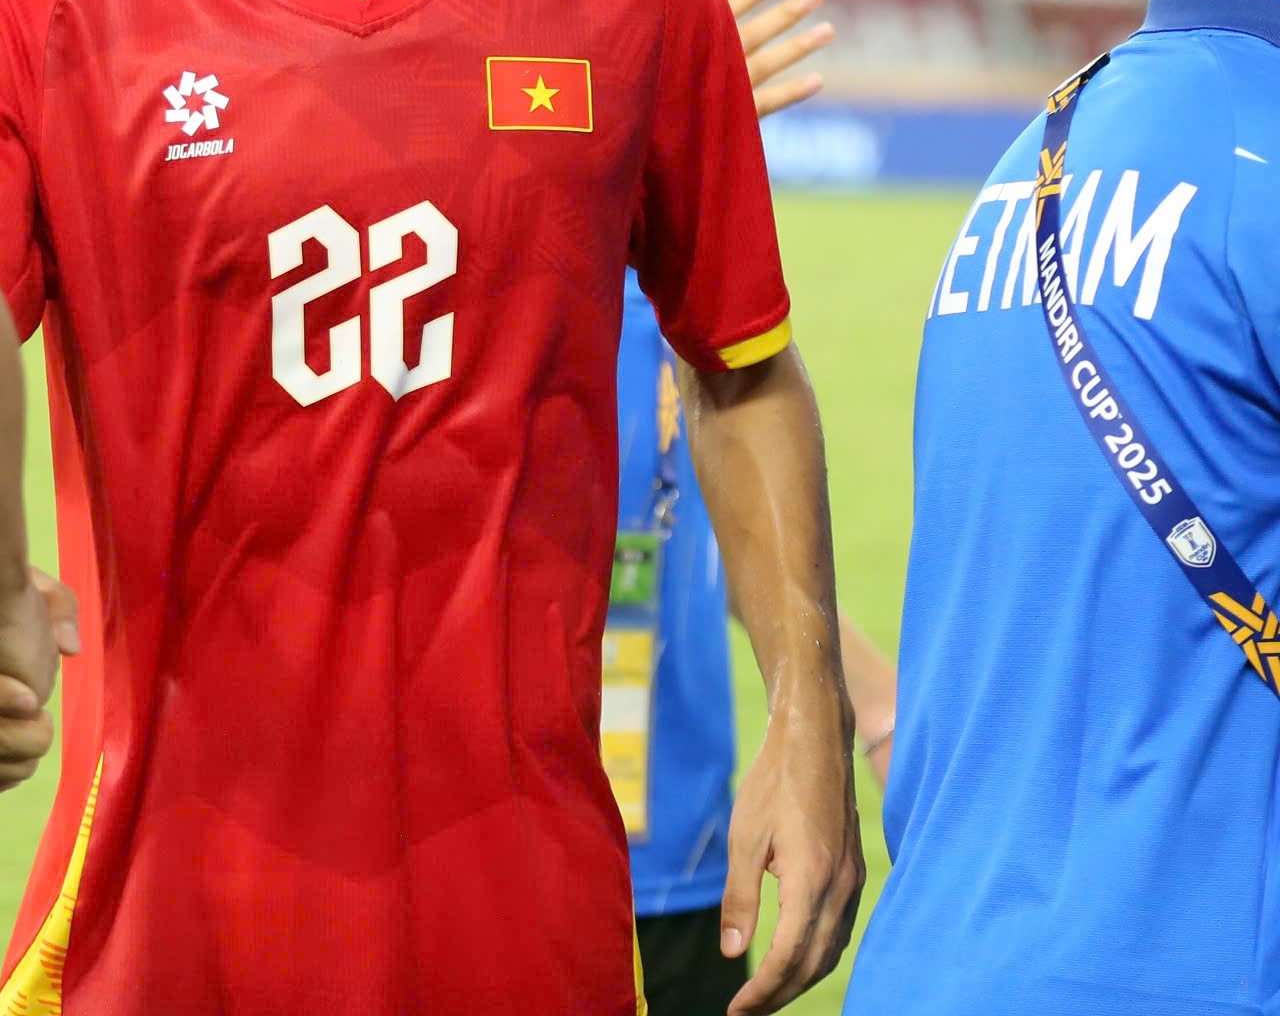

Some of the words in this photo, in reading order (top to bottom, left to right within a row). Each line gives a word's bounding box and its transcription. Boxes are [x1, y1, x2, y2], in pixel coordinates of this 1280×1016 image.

[165, 138, 234, 161] JOGARBOLA
[268, 200, 458, 407] 22
[1039, 233, 1083, 364] MANDIRI
[1071, 360, 1120, 421] CUP
[1104, 424, 1173, 506] 2025
